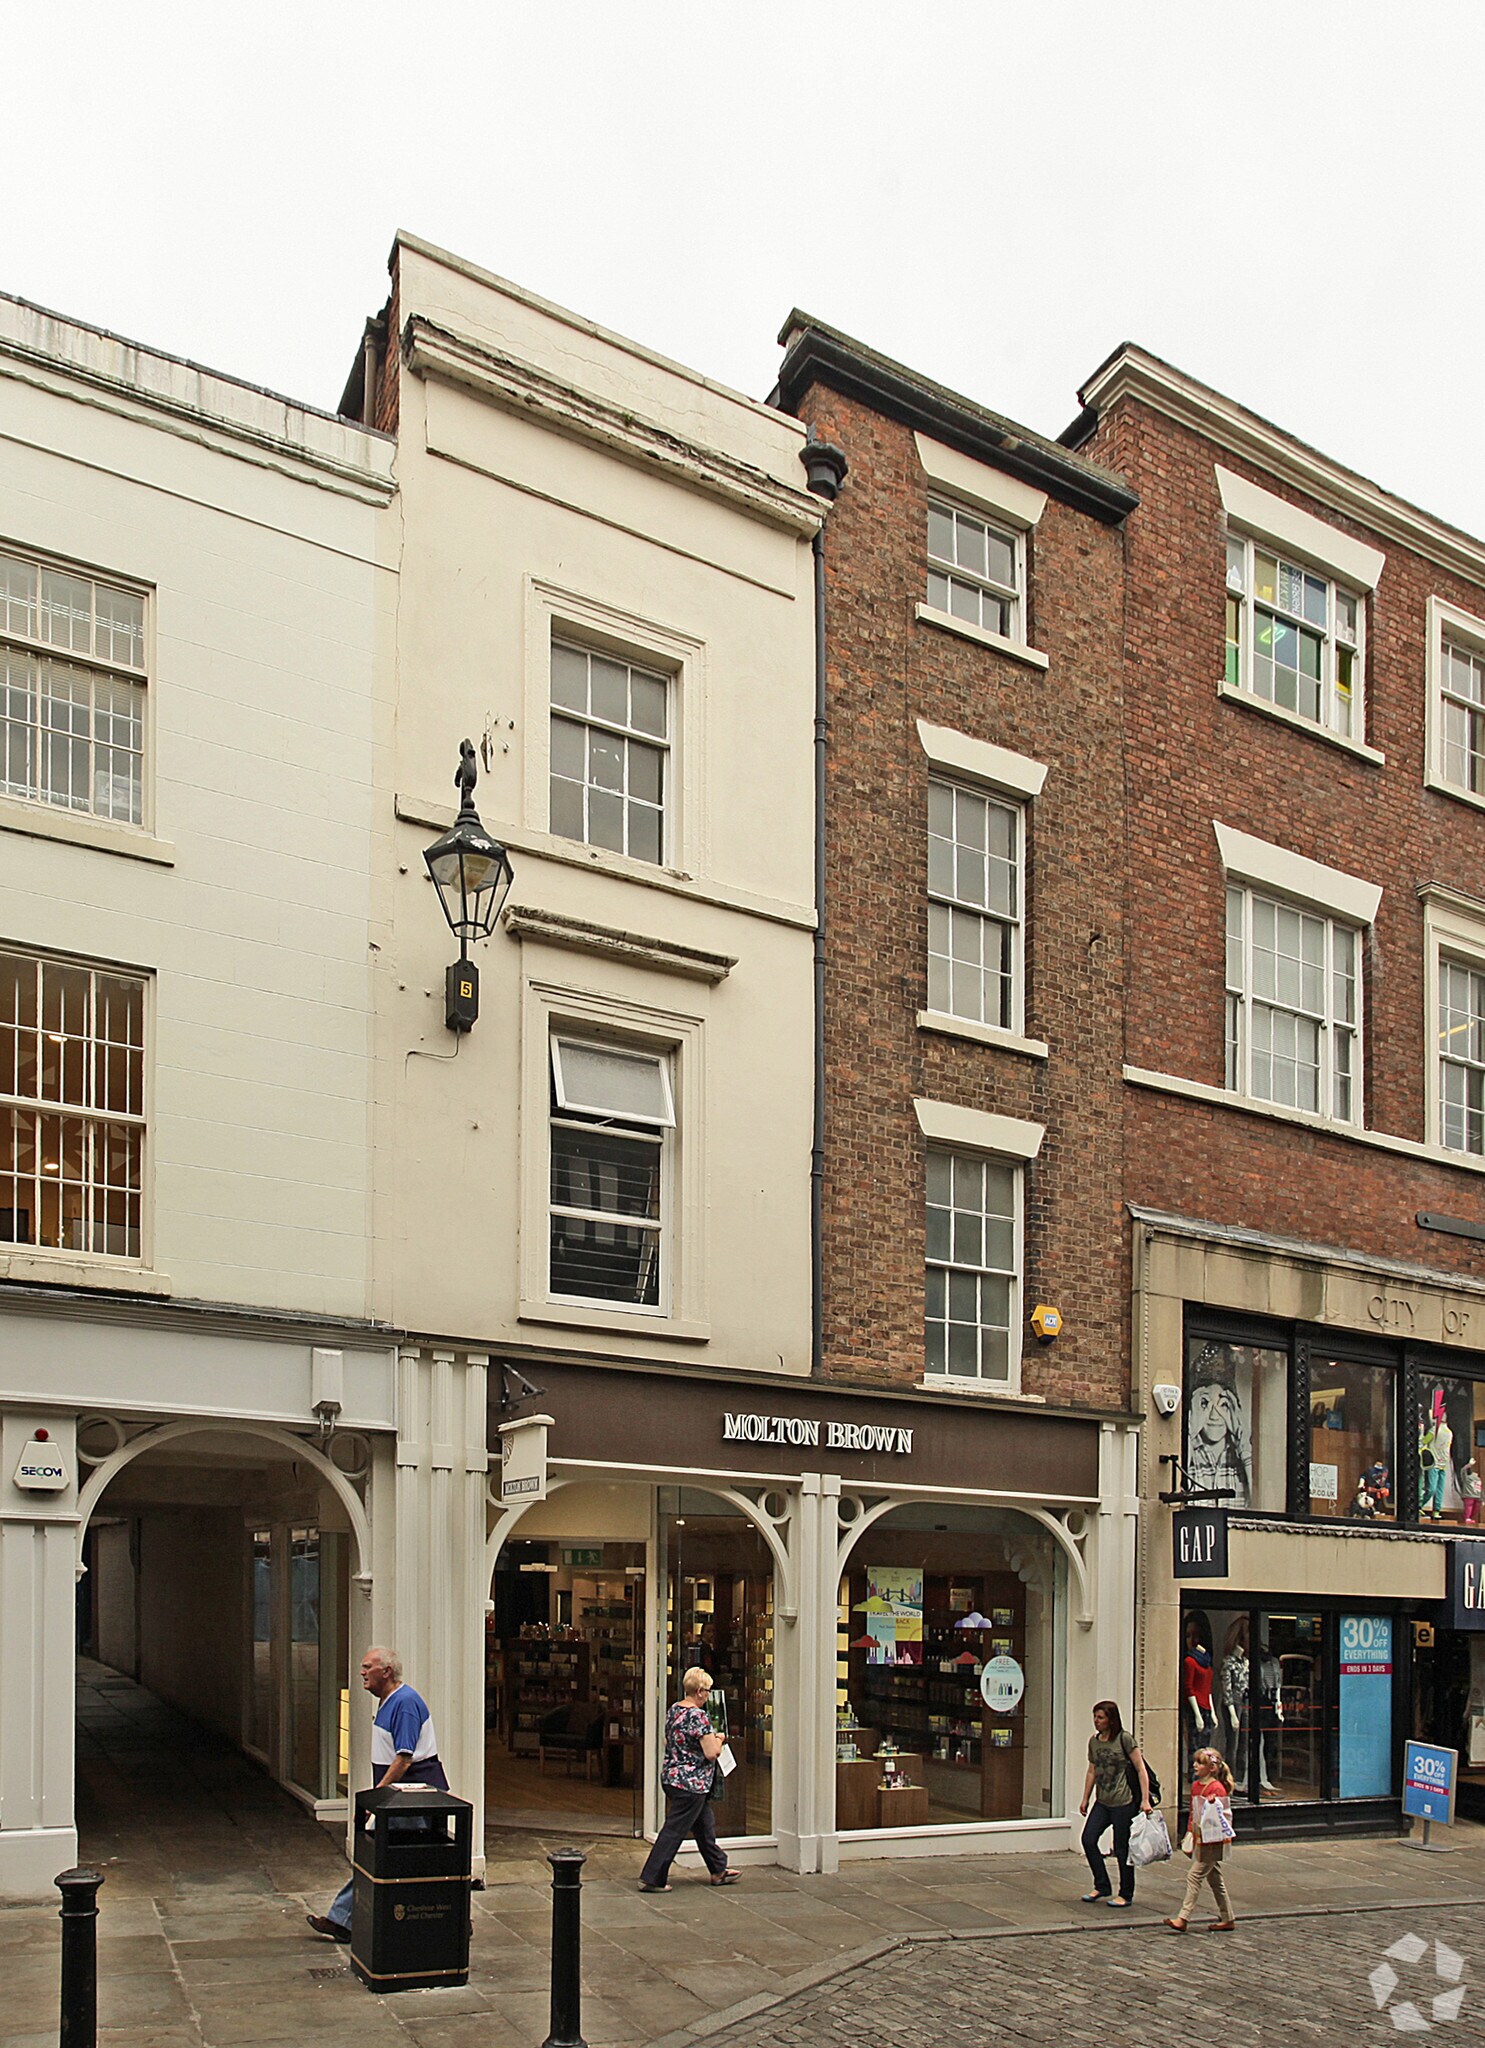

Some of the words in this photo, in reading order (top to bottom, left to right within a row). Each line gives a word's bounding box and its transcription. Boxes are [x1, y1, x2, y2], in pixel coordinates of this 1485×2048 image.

[462, 984, 471, 995] 5
[1367, 1296, 1420, 1328] CITY
[1444, 1310, 1470, 1337] OF
[723, 1412, 820, 1446] MOLTON
[826, 1421, 914, 1453] BROWN
[21, 1466, 62, 1477] SECOM
[1180, 1524, 1216, 1563] GAP
[1343, 1617, 1388, 1649] 30%
[1373, 1639, 1388, 1648] OFF
[1343, 1649, 1389, 1660] EVERYTHING
[1413, 1755, 1446, 1776] 30%
